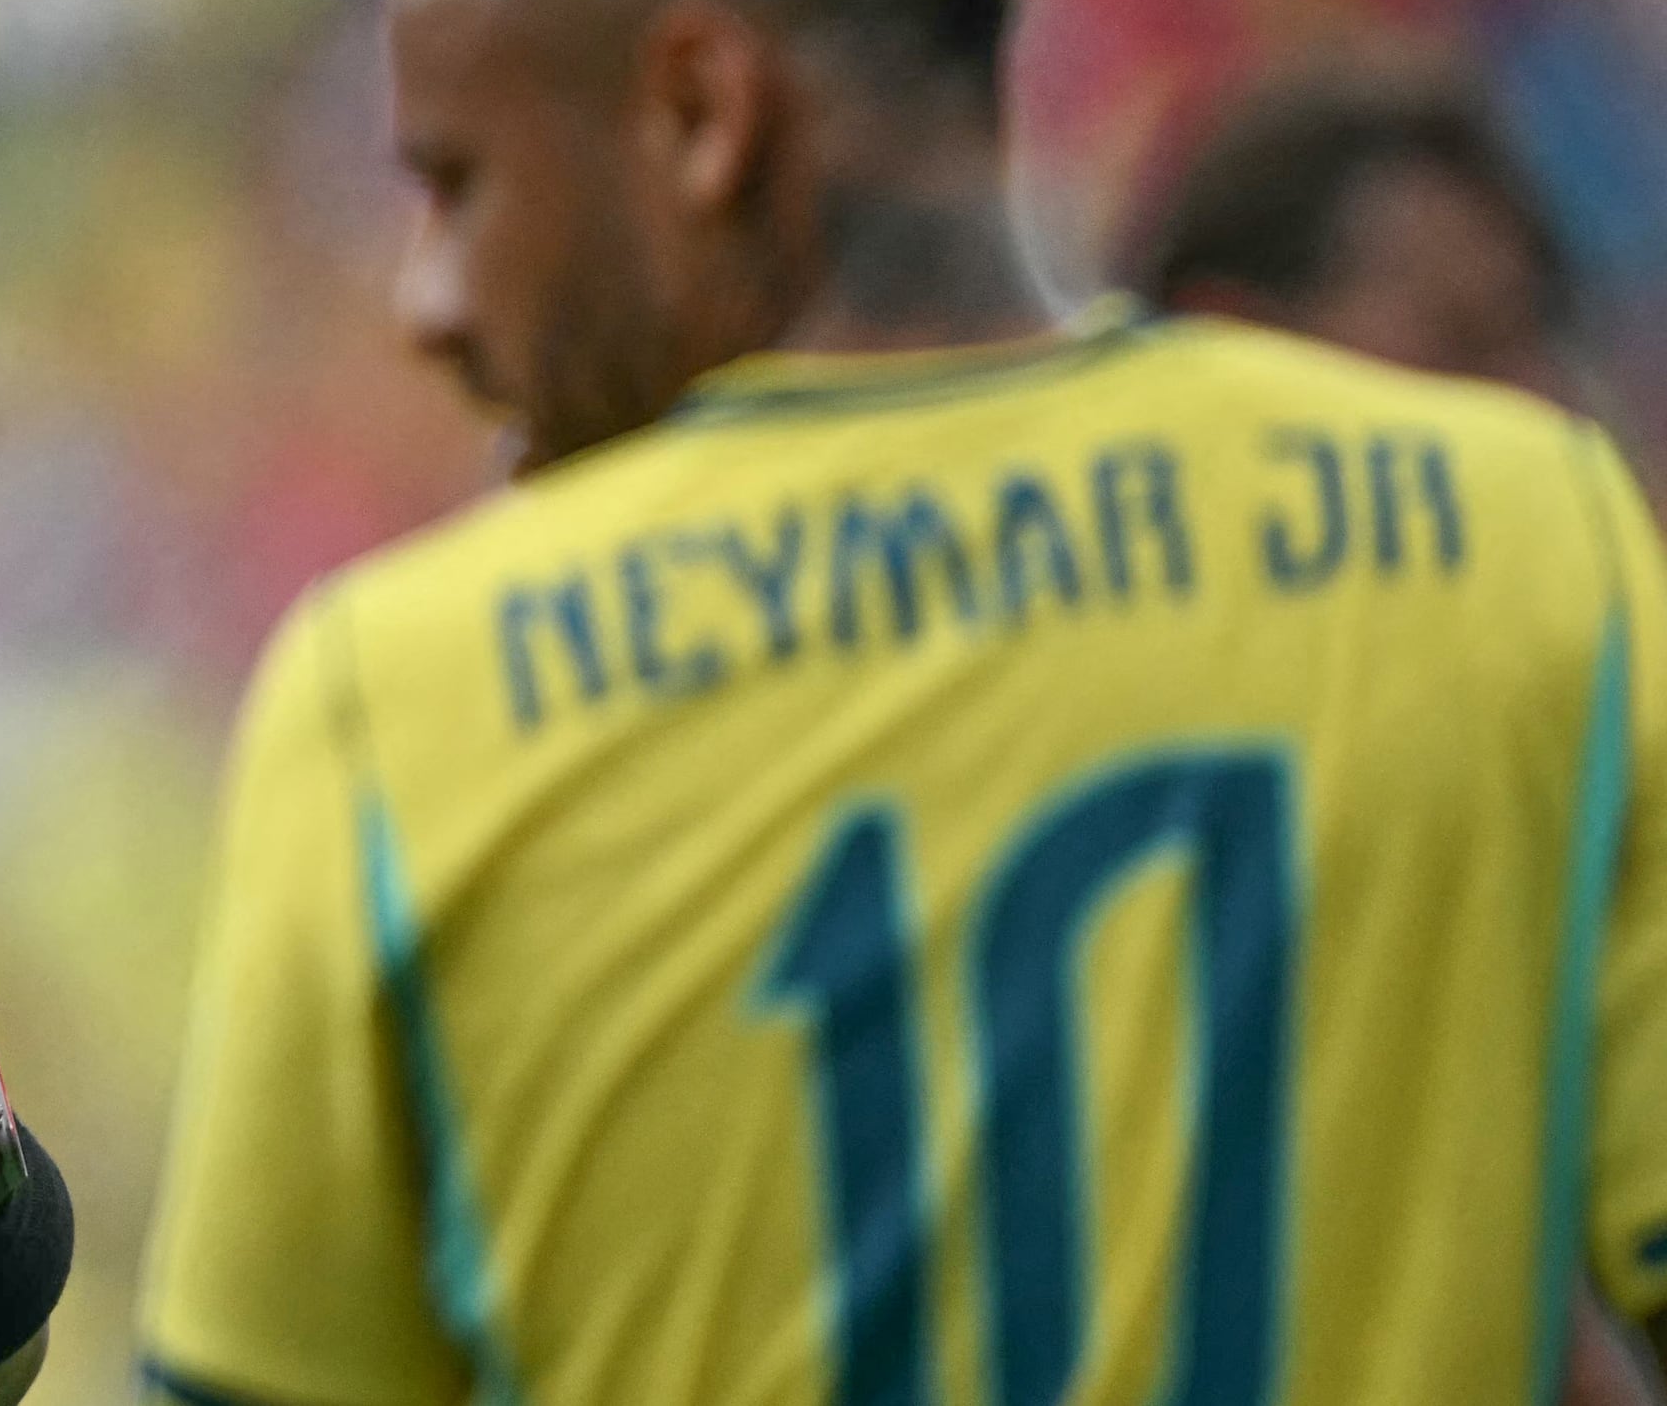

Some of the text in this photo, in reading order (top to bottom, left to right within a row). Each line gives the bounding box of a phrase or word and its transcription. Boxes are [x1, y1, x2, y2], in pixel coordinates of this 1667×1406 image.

[500, 426, 1469, 730] NEYMAR JR
[743, 734, 1301, 1406] 10
